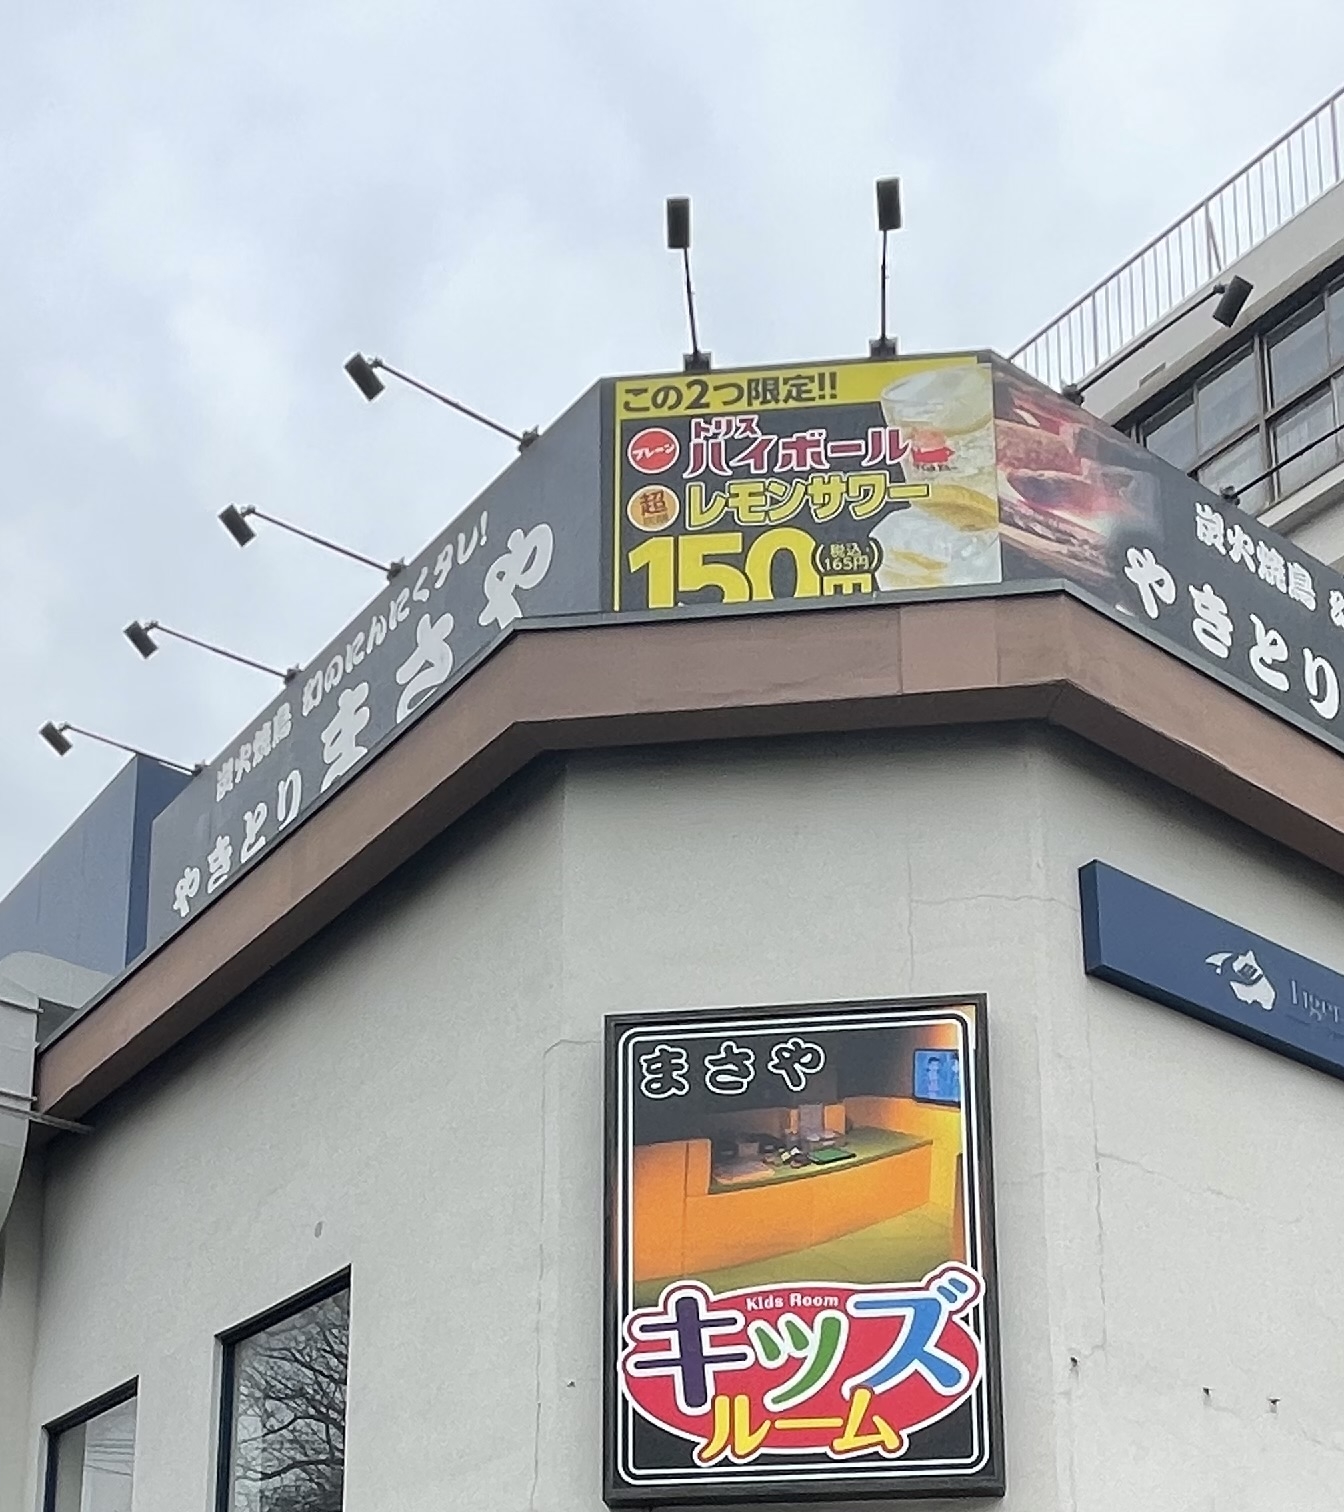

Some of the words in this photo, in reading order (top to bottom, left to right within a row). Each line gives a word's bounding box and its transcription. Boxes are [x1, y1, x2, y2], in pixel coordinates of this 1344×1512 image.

[623, 372, 837, 412] この2つ限定!!
[684, 427, 912, 478] ハイボール
[691, 415, 760, 439] トリス
[685, 472, 930, 529] レモンサワー
[1195, 503, 1317, 611] 炭火焼鳥
[1124, 546, 1340, 720] やきとり
[173, 769, 303, 917] やきとり
[320, 523, 554, 794] まさや
[640, 1038, 826, 1098] まさや
[746, 1296, 784, 1310] Kids
[790, 1293, 839, 1308] Room
[628, 1270, 976, 1410] キッズ
[699, 1387, 905, 1462] ルーム
